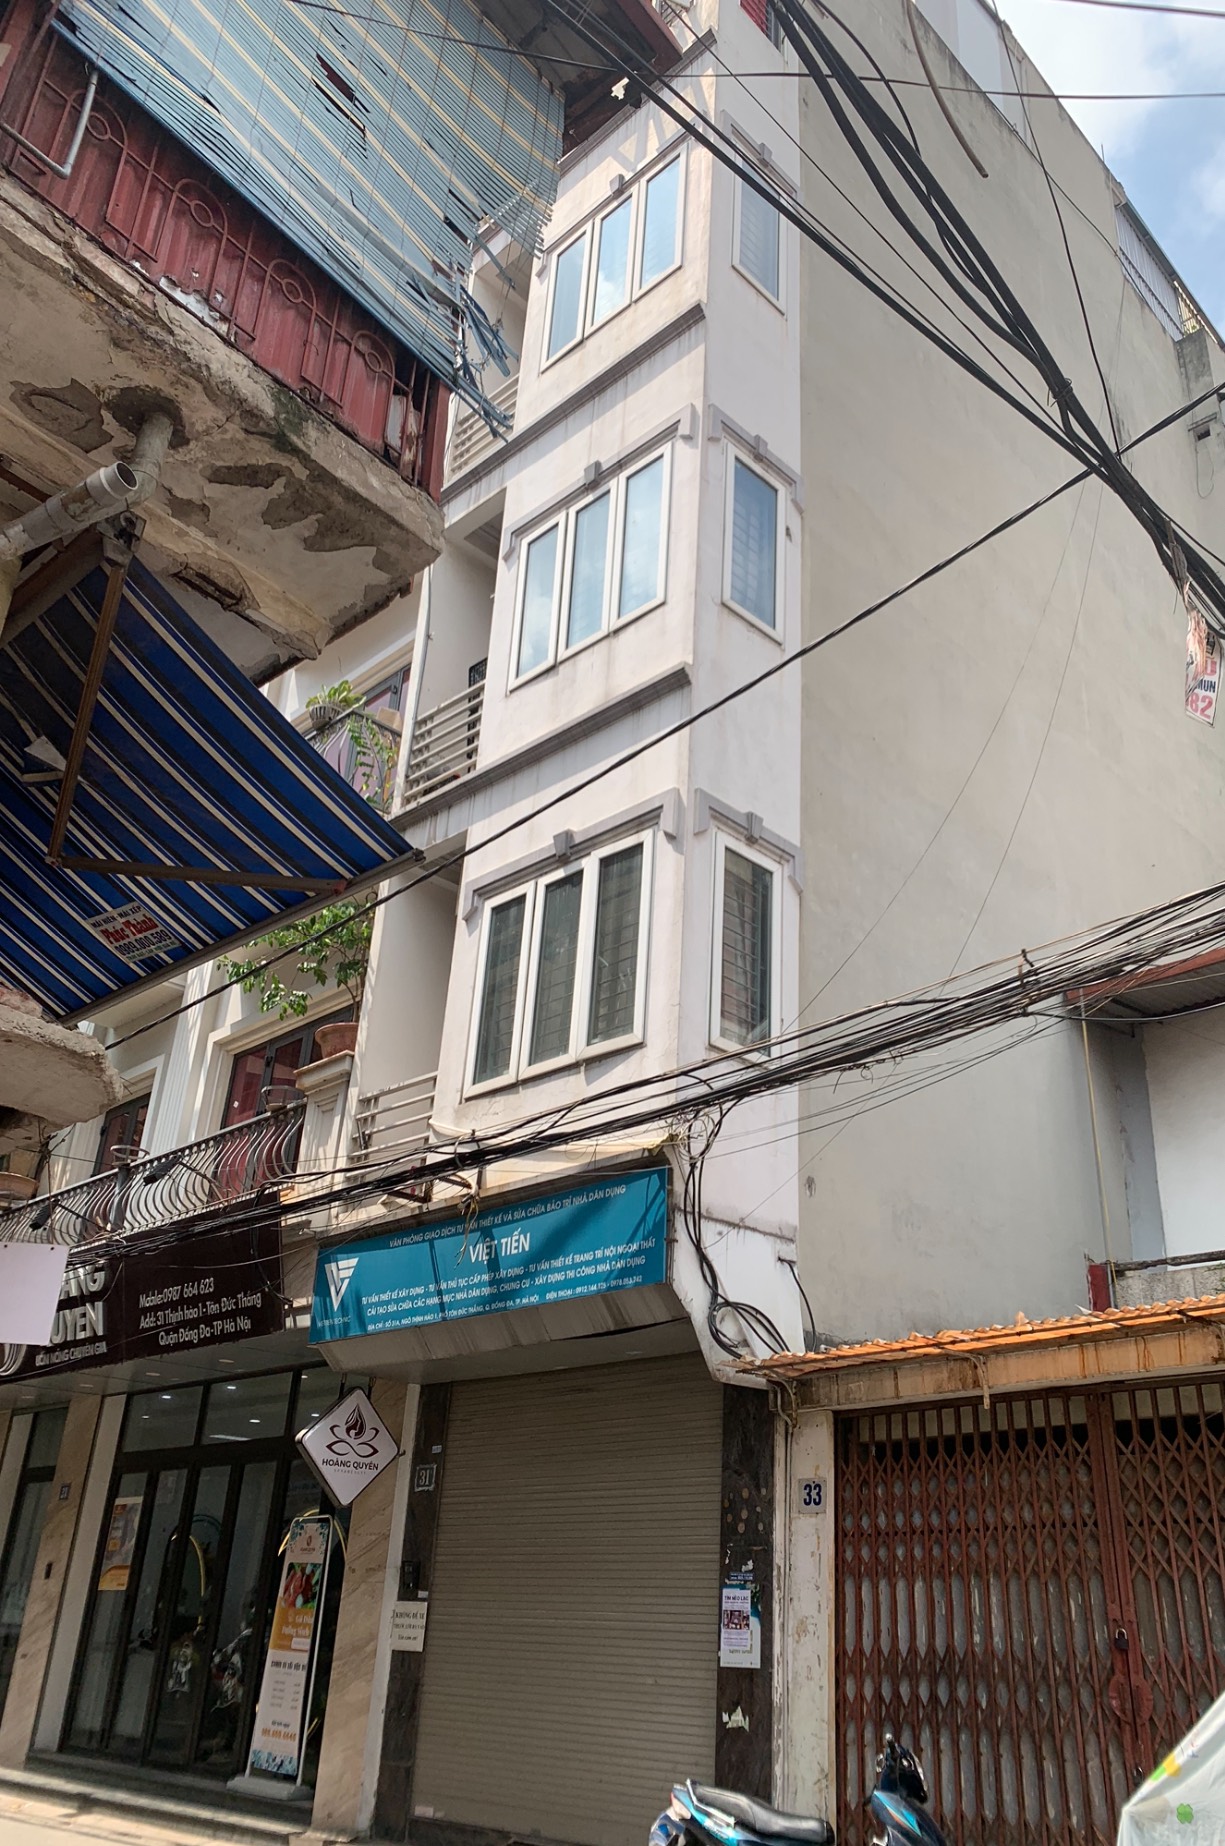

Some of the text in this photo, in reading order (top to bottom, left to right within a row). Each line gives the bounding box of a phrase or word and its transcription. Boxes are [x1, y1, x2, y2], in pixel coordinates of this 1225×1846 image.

[100, 914, 159, 944] Phúc Thành
[114, 929, 172, 956] 0989.000.589
[390, 1239, 402, 1248] VĂN
[402, 1233, 423, 1245] PHÒNG
[424, 1230, 440, 1240] GIAO
[440, 1226, 456, 1238] DỊCH
[572, 1192, 587, 1206] NHÀ
[589, 1190, 604, 1201] DÂN
[605, 1185, 626, 1198] DỤNG
[470, 1227, 530, 1264] VIỆT TIẾN
[183, 1282, 198, 1298] 664
[200, 1278, 214, 1294] 623
[156, 1311, 164, 1325] 31
[165, 1306, 184, 1325] Thịnh
[184, 1304, 198, 1320] hào
[221, 1296, 236, 1312] Đức
[159, 1331, 178, 1346] Quận
[179, 1326, 198, 1343] Đống
[224, 1318, 235, 1333] Hà
[236, 1315, 251, 1332] Nội
[322, 1458, 379, 1471] HOÀNG QUYÊN
[420, 1469, 430, 1485] 31
[804, 1484, 822, 1506] 33
